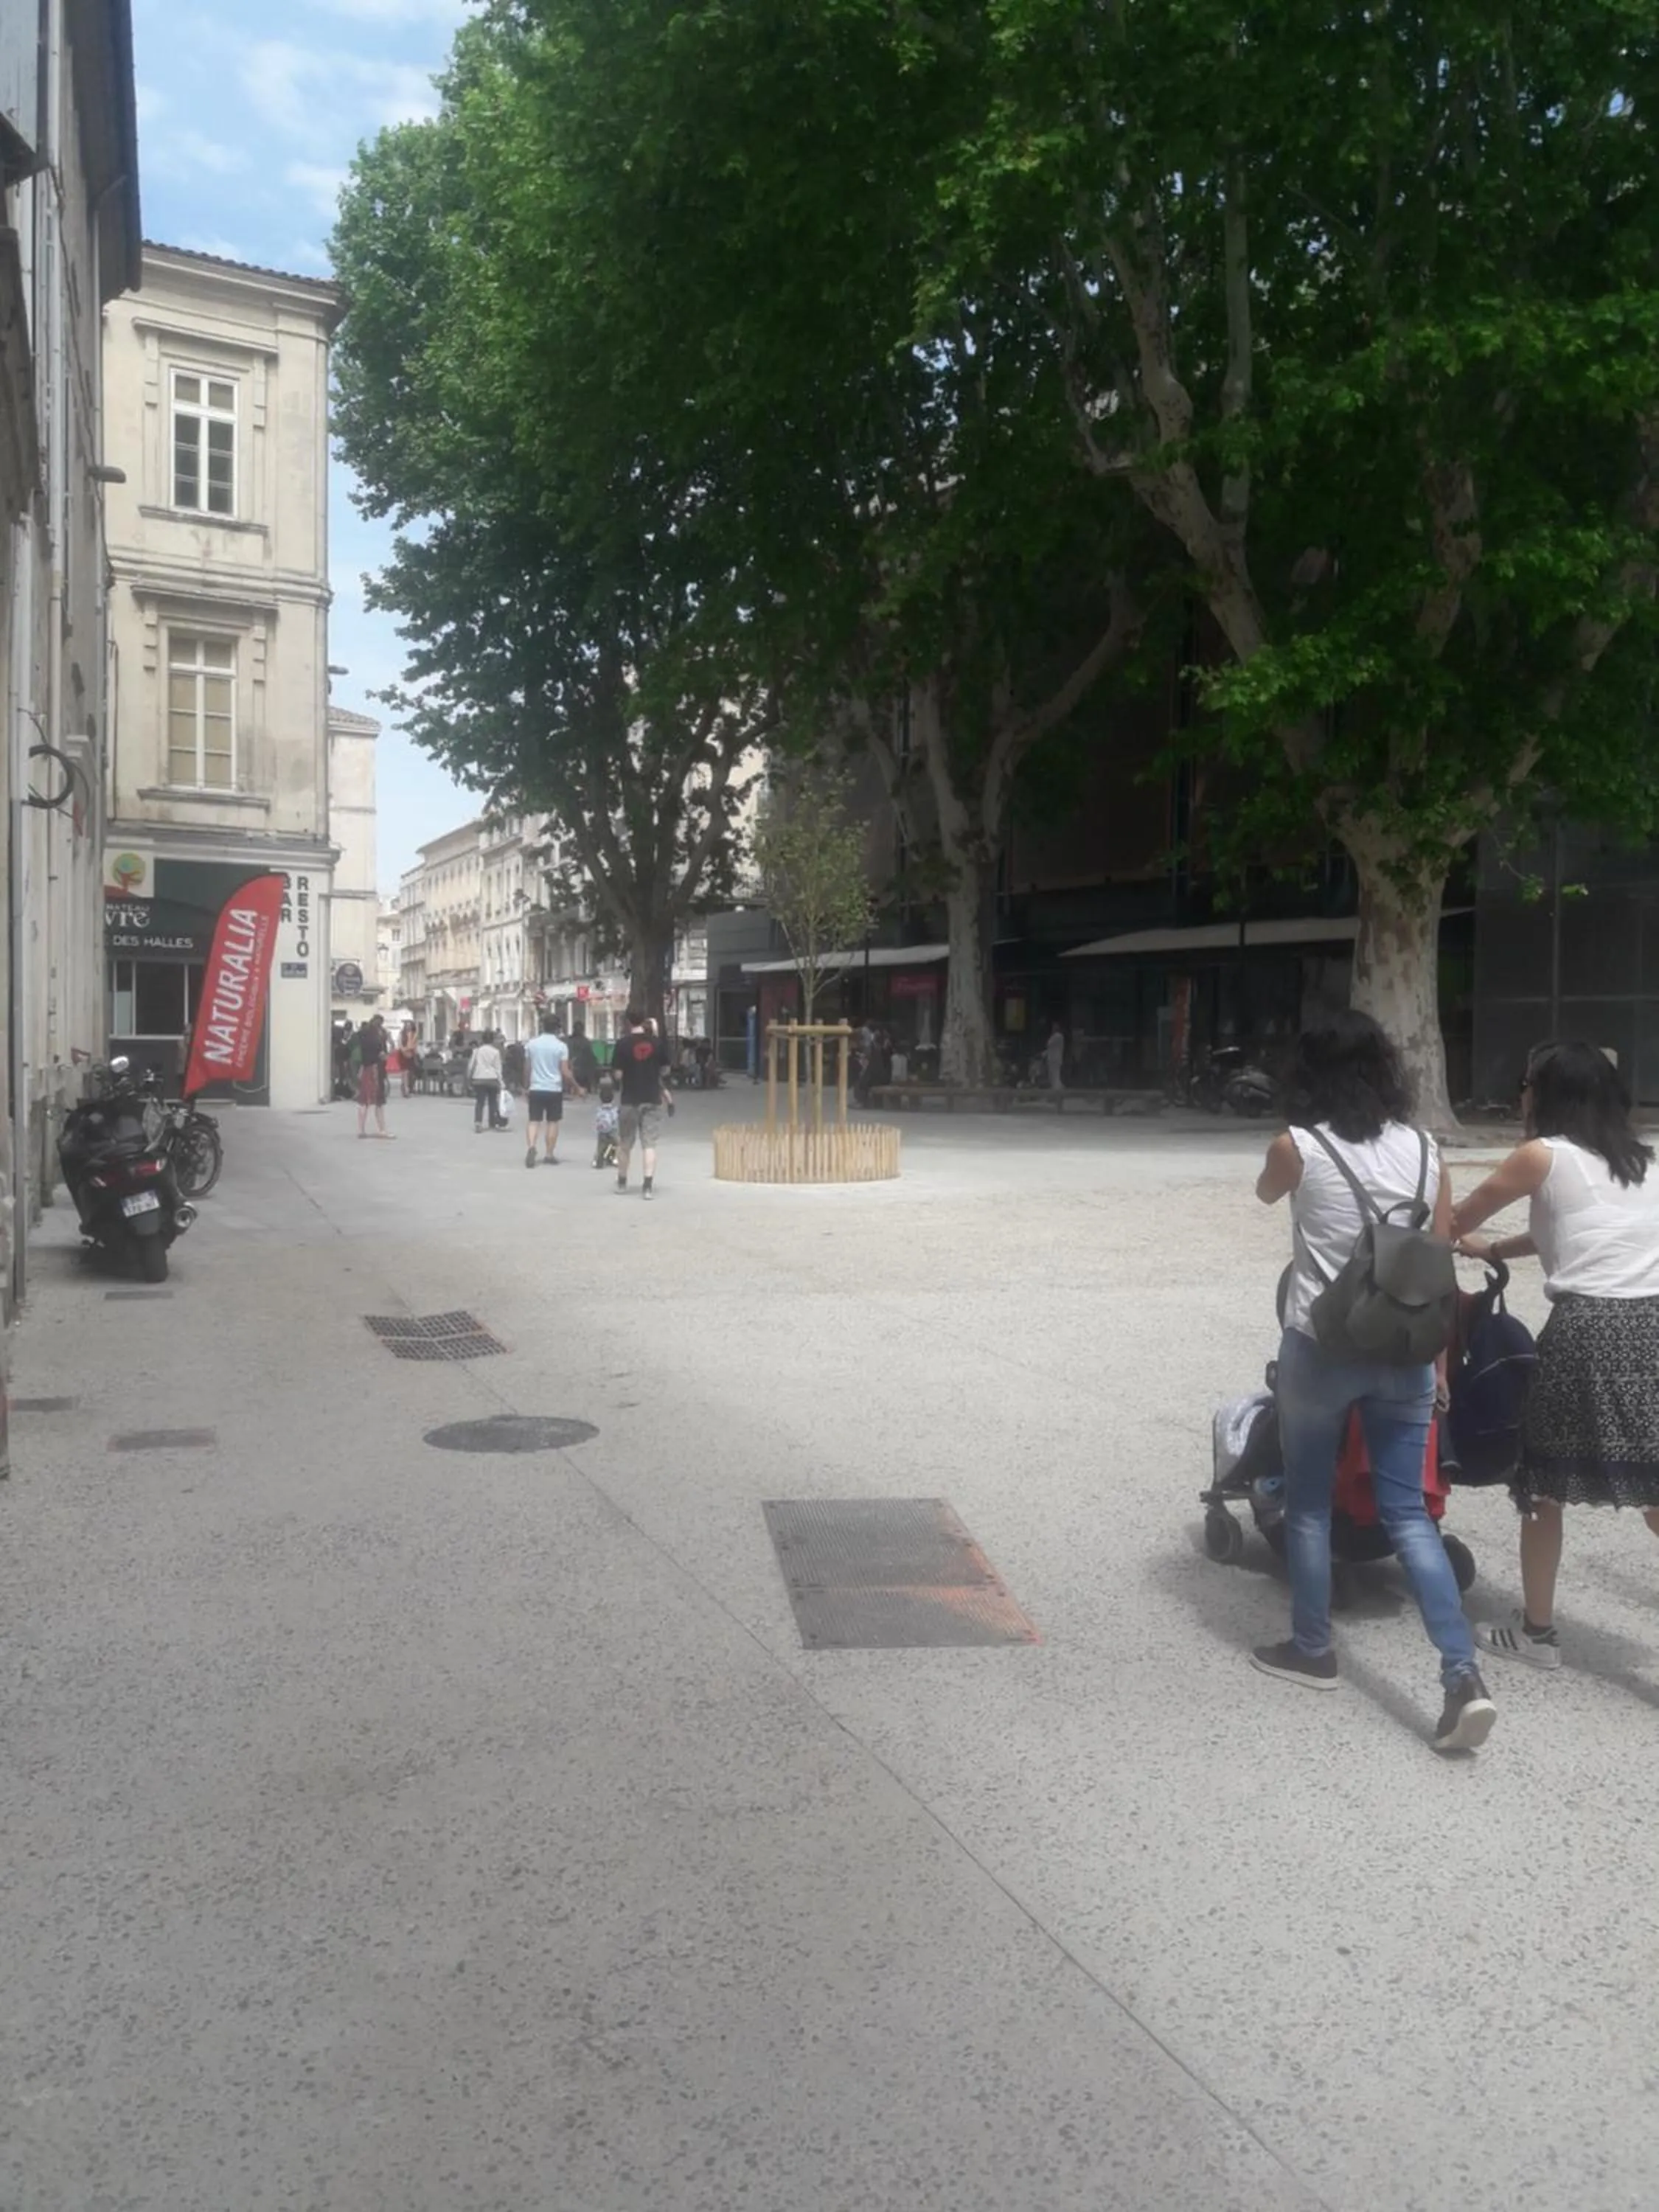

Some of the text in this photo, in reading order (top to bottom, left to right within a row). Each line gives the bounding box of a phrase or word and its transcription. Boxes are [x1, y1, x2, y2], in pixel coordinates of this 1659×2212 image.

[112, 934, 194, 949] DES HALLES
[296, 875, 309, 957] RESTO
[204, 908, 258, 1065] NATURALIA
